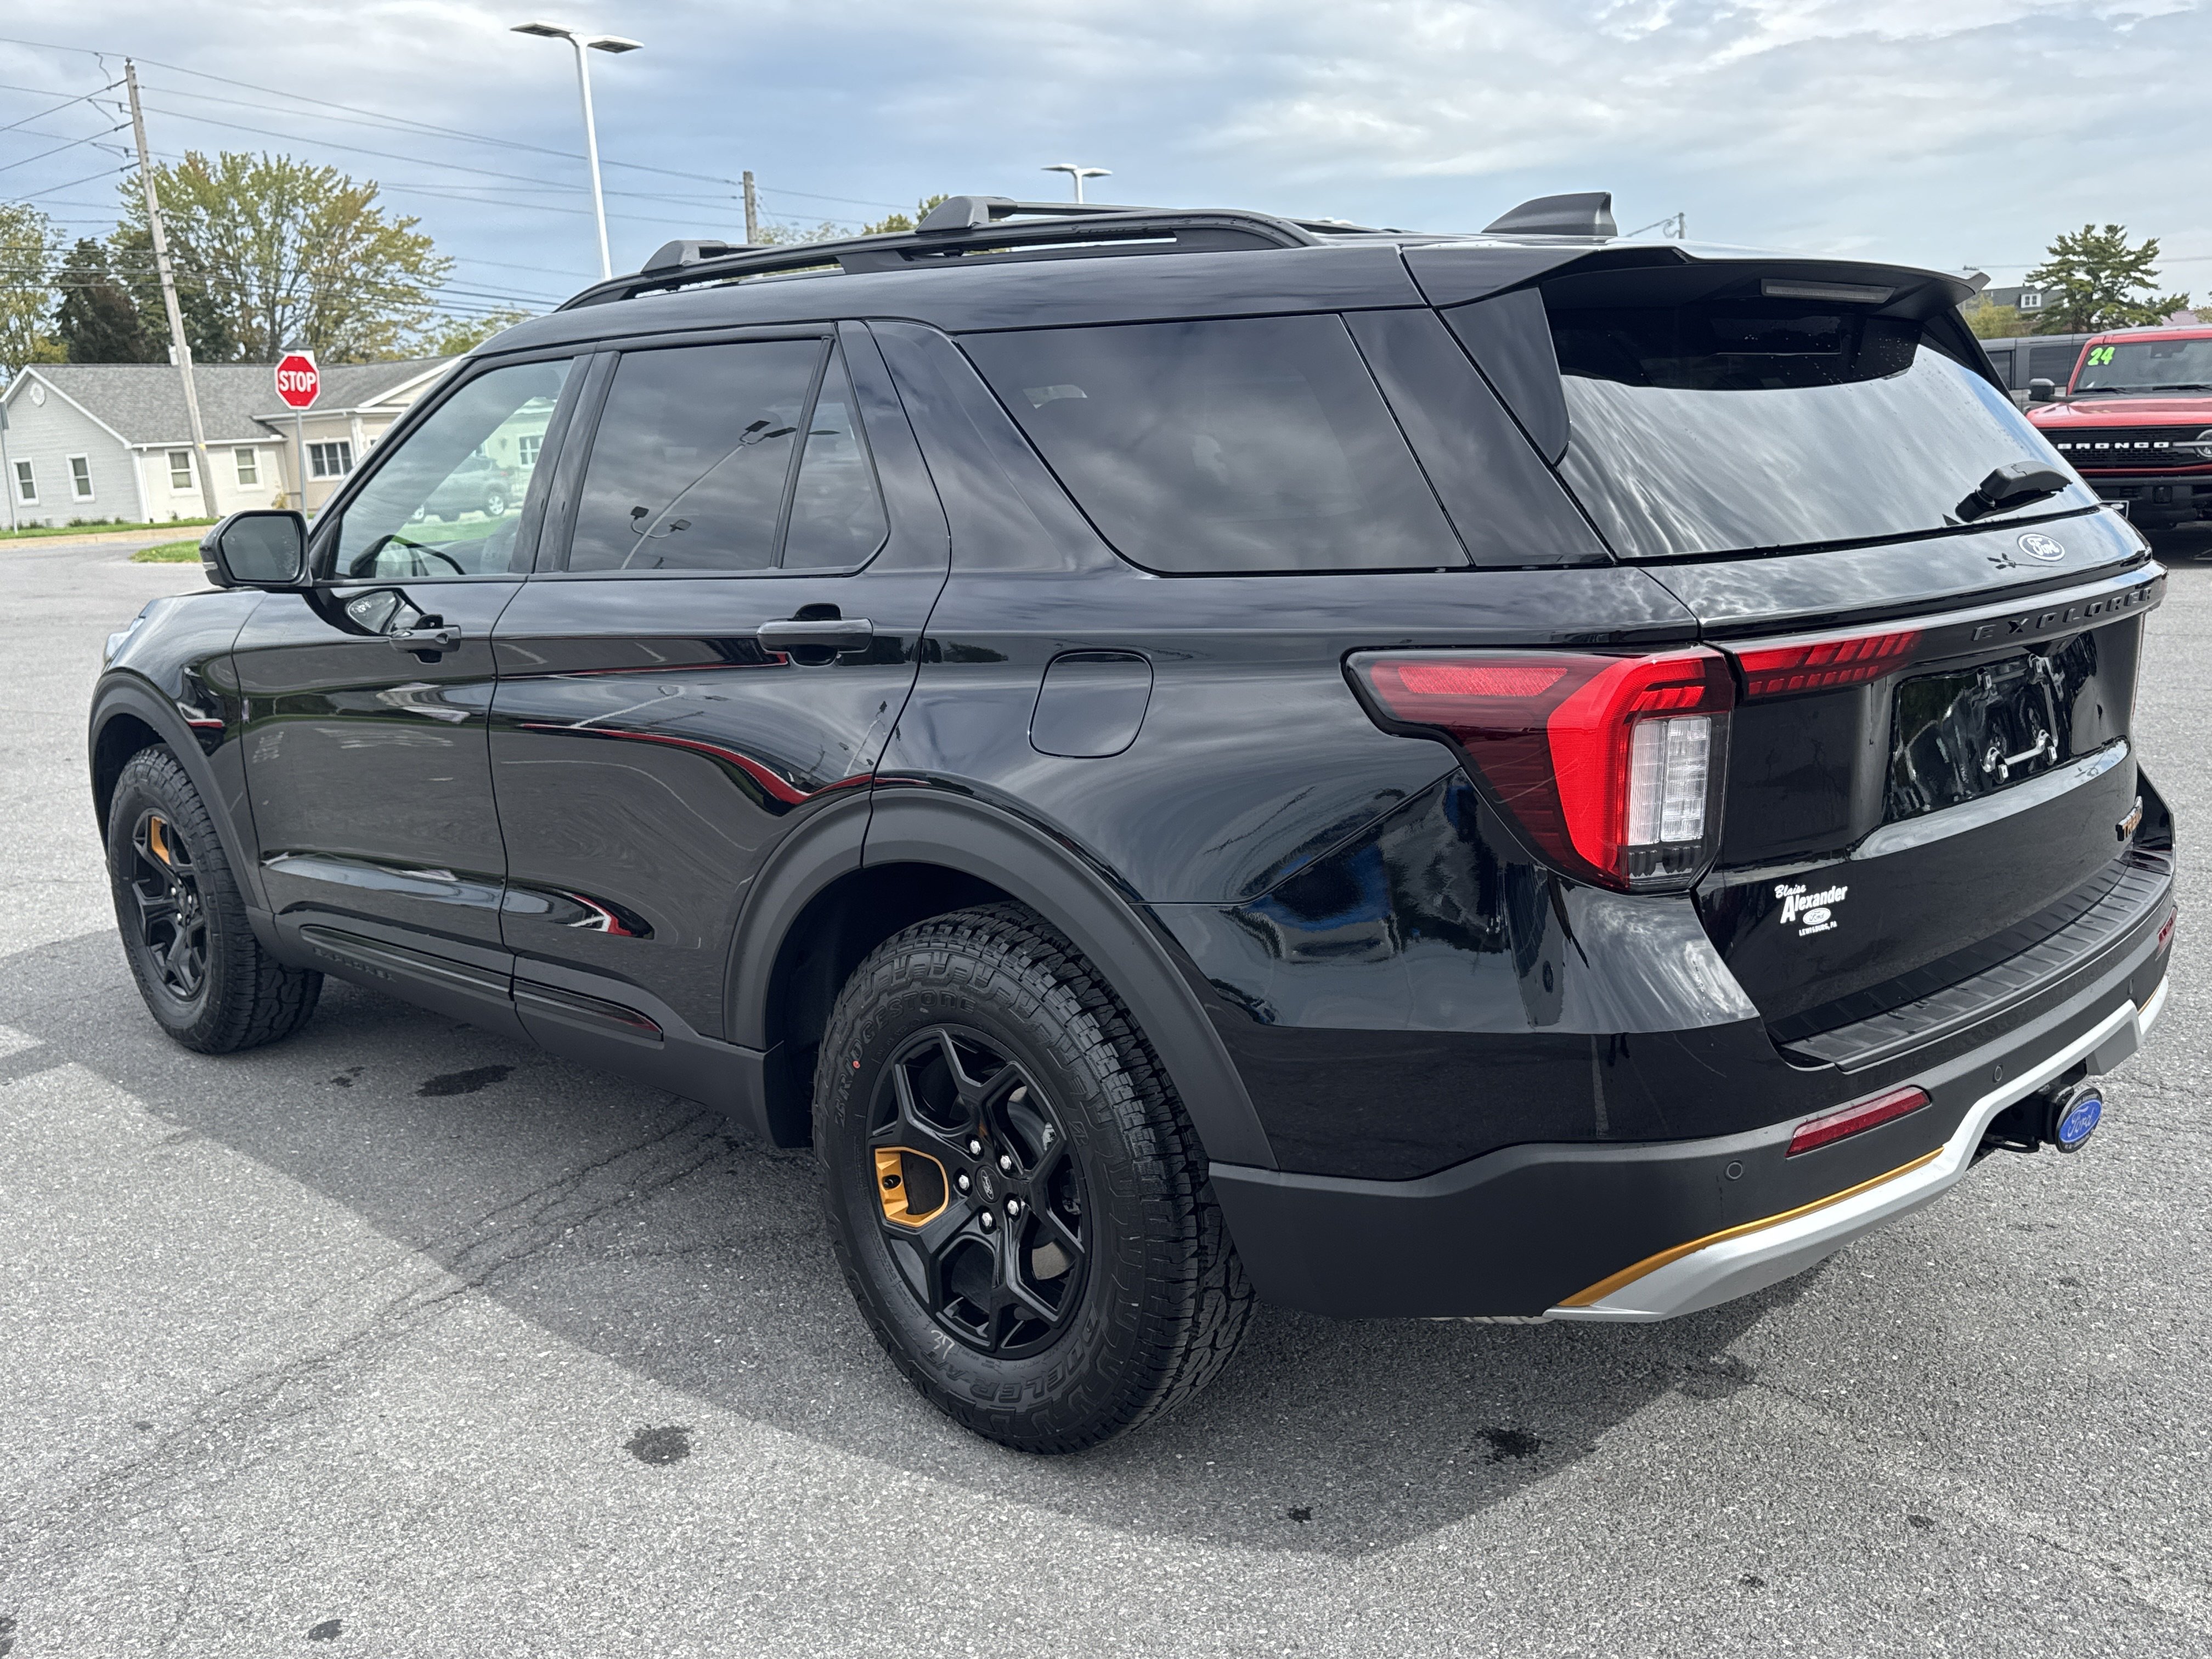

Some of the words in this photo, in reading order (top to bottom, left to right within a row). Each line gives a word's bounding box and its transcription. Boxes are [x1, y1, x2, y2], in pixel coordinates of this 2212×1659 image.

[2088, 347, 2115, 365] 24
[279, 370, 316, 392] STOP
[1971, 586, 2152, 641] EXPLORER
[1774, 884, 1807, 899] Blaise
[1780, 885, 1848, 924] Alexander
[834, 990, 977, 1130] BRIDGESTONE
[2067, 1105, 2096, 1138] Ford
[970, 1301, 1098, 1403] DUELER
